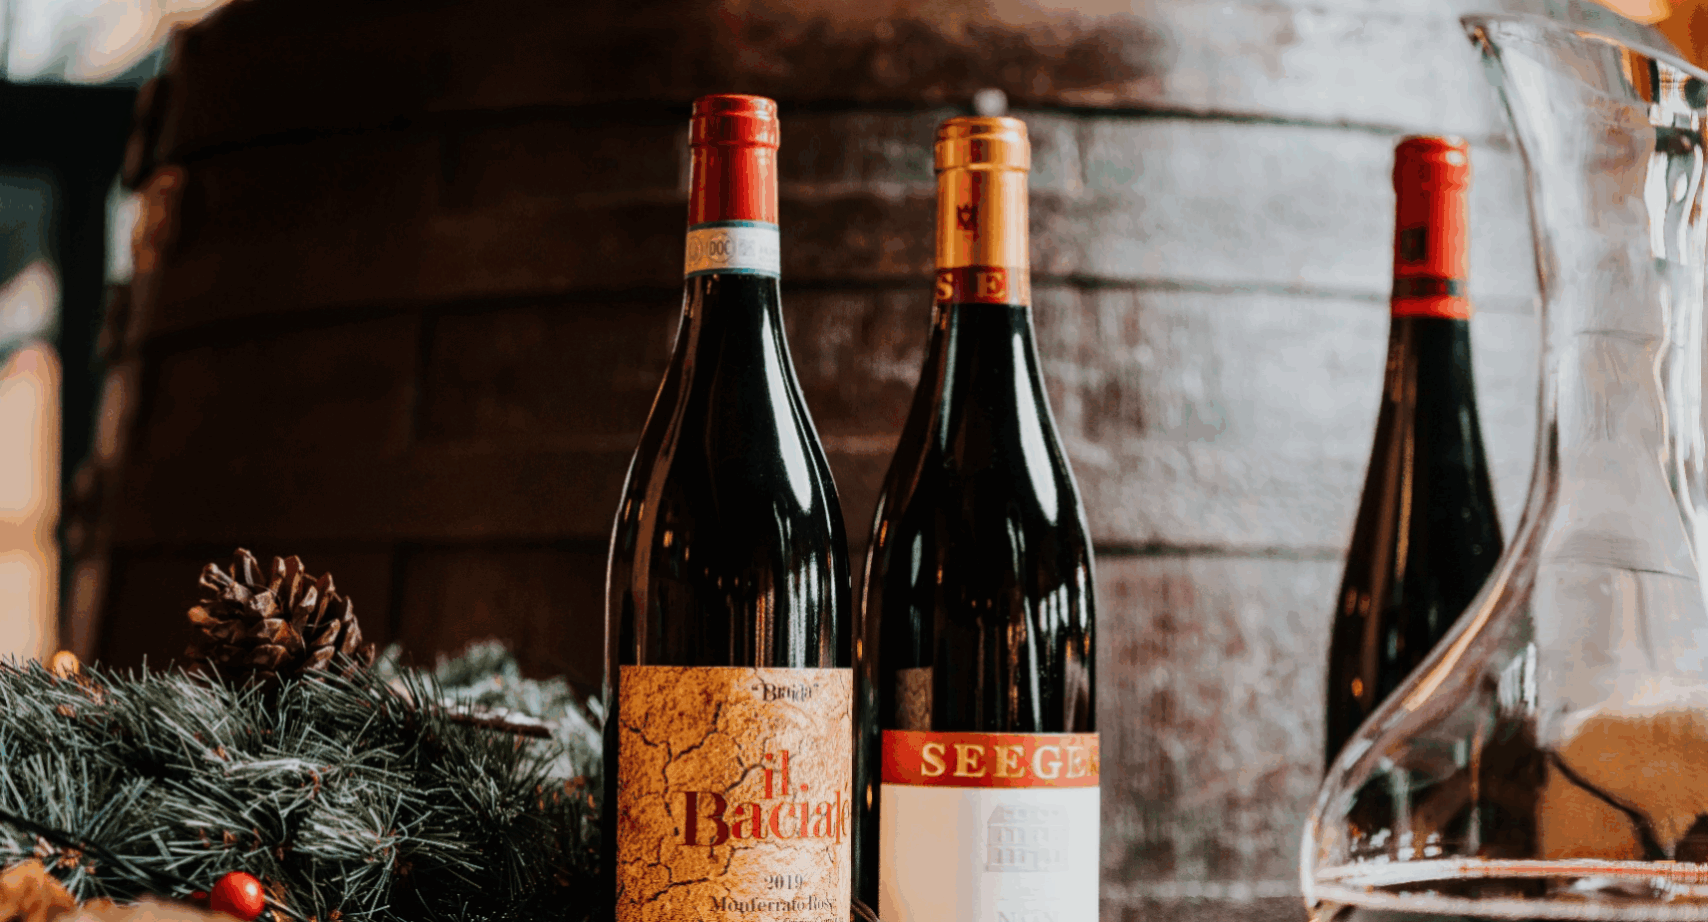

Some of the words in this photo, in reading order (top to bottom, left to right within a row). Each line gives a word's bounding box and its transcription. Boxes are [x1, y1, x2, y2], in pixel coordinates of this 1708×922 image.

[709, 240, 730, 256] DOC
[764, 874, 803, 889] 2019
[708, 895, 805, 913] Monferrato
